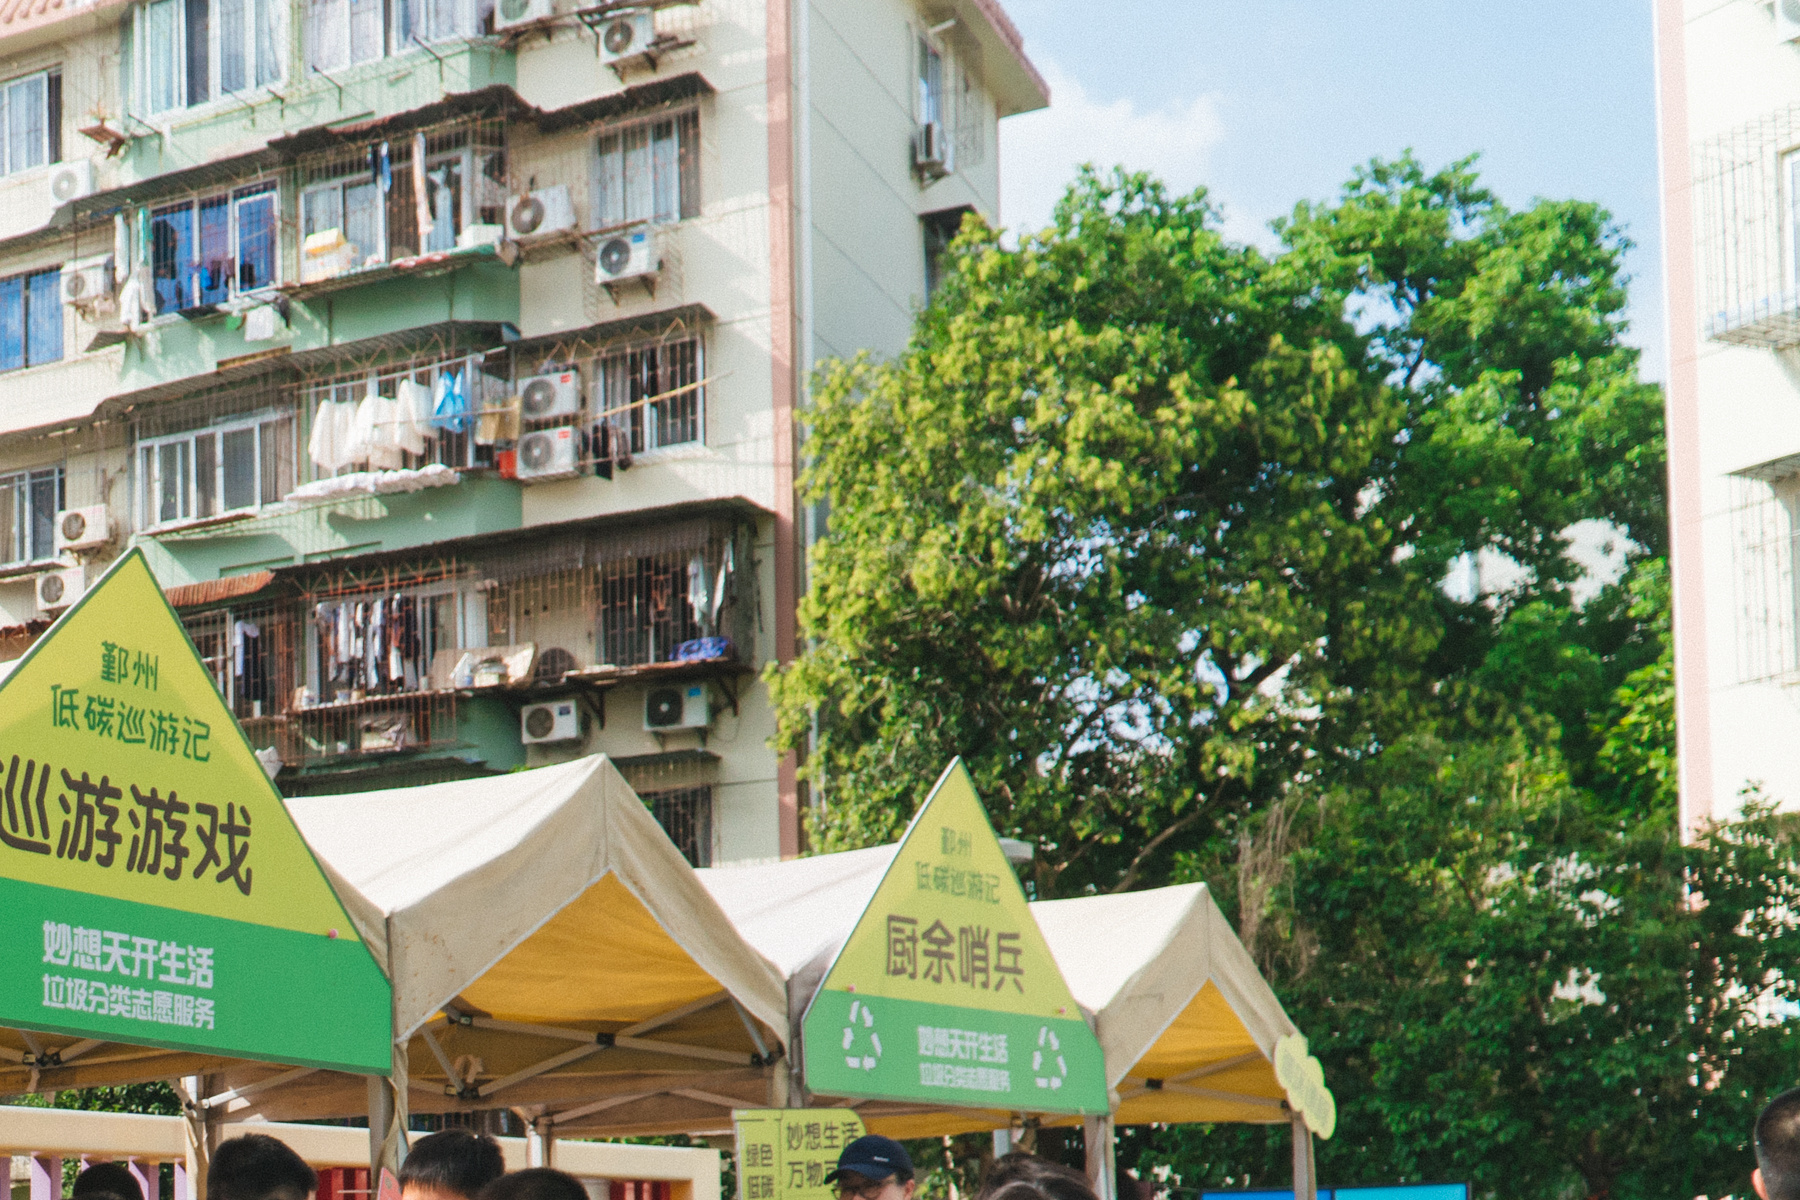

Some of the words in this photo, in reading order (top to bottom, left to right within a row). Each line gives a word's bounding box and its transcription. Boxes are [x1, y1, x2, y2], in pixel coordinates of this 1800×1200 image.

[101, 640, 158, 691] 鄞州
[51, 683, 211, 763] 低碳巡游记
[43, 920, 214, 990] 妙想天开生活
[886, 914, 1025, 995] 厨余哨兵
[43, 973, 215, 1031] 垃圾分类志愿服务
[746, 1143, 774, 1168] 绿色
[786, 1121, 860, 1151] 妙想生活
[747, 1174, 775, 1199] 低碳
